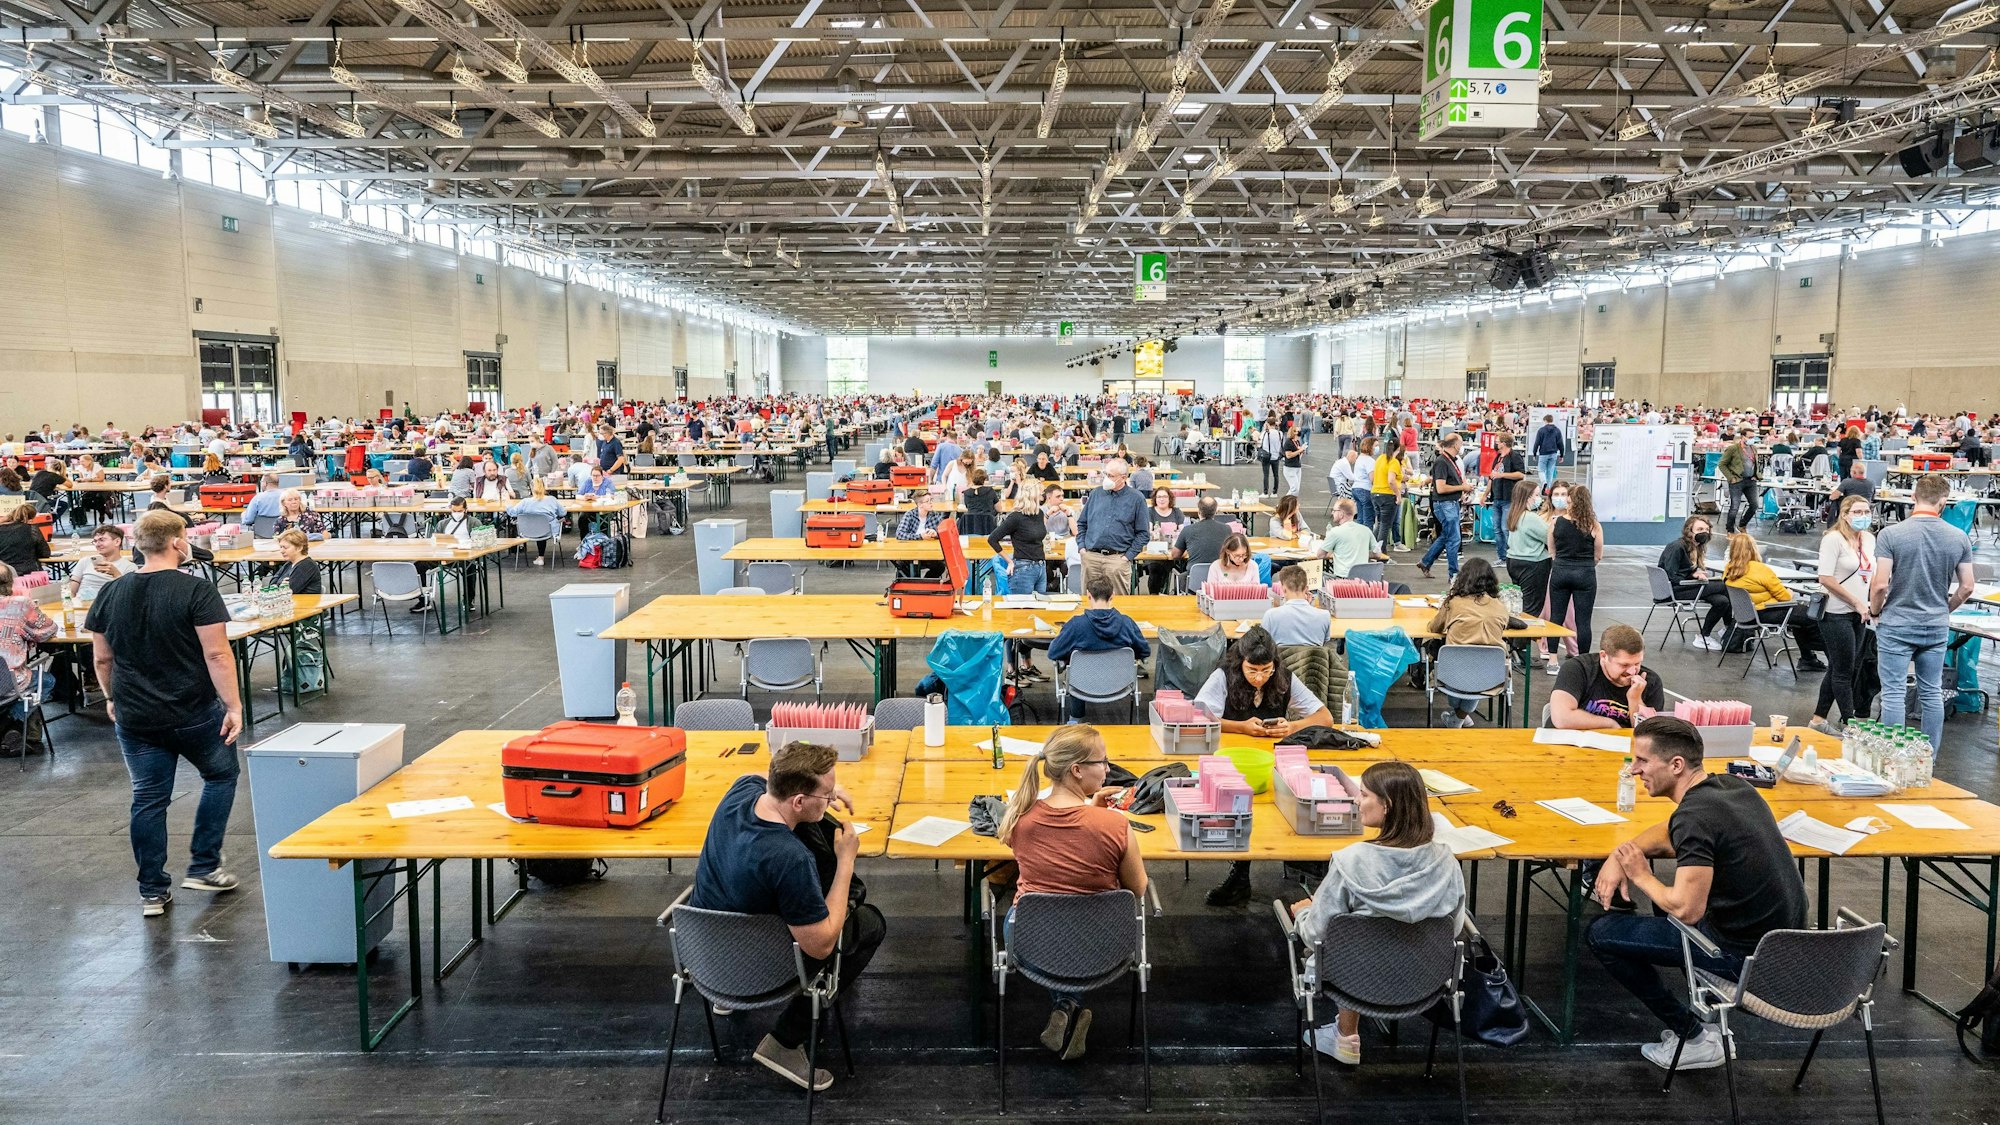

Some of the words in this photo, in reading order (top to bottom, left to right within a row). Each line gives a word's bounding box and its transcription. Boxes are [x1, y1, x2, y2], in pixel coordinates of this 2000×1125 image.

[1435, 15, 1450, 76] 6
[1493, 11, 1533, 69] 6
[1149, 261, 1164, 282] 6
[1064, 325, 1072, 336] 6
